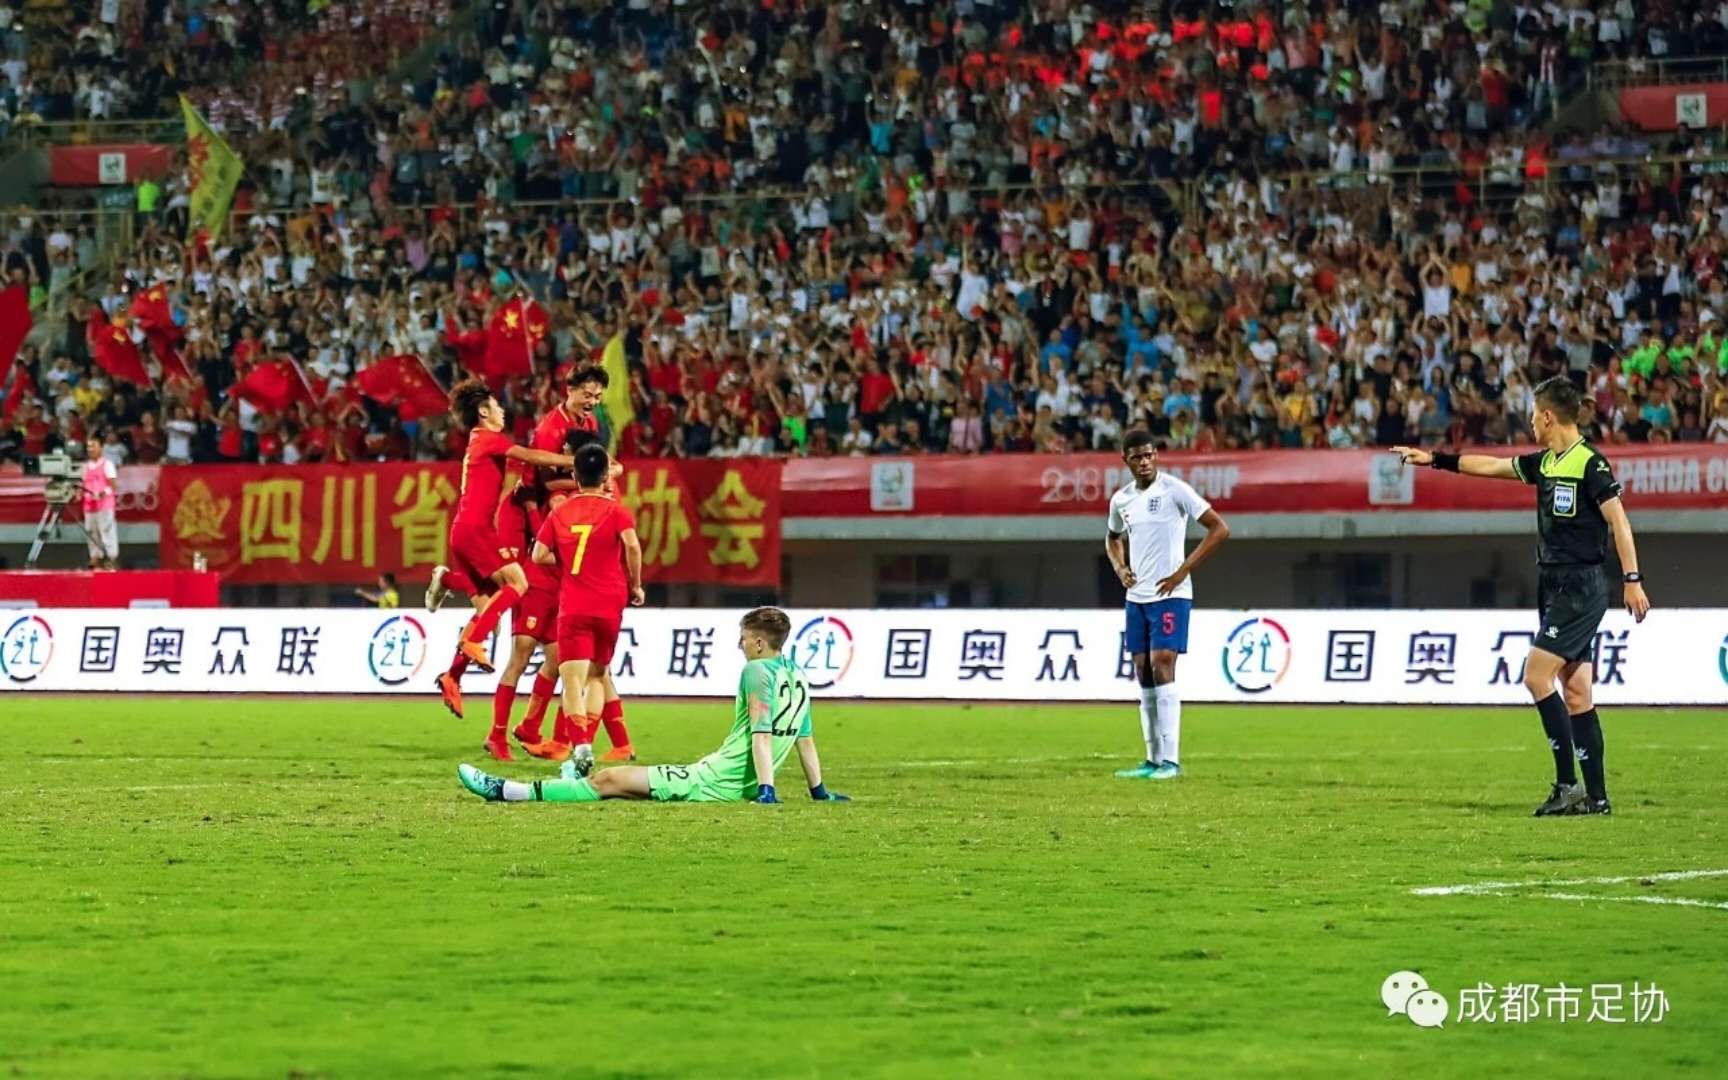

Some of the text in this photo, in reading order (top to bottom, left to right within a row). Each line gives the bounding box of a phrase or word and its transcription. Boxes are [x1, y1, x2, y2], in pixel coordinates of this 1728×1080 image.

[1615, 455, 1728, 493] PANDA C
[239, 469, 767, 569] 四川省协会
[570, 524, 593, 575] 7
[1162, 611, 1176, 635] 5
[79, 626, 321, 675] 国奥众联
[771, 680, 807, 737] 22
